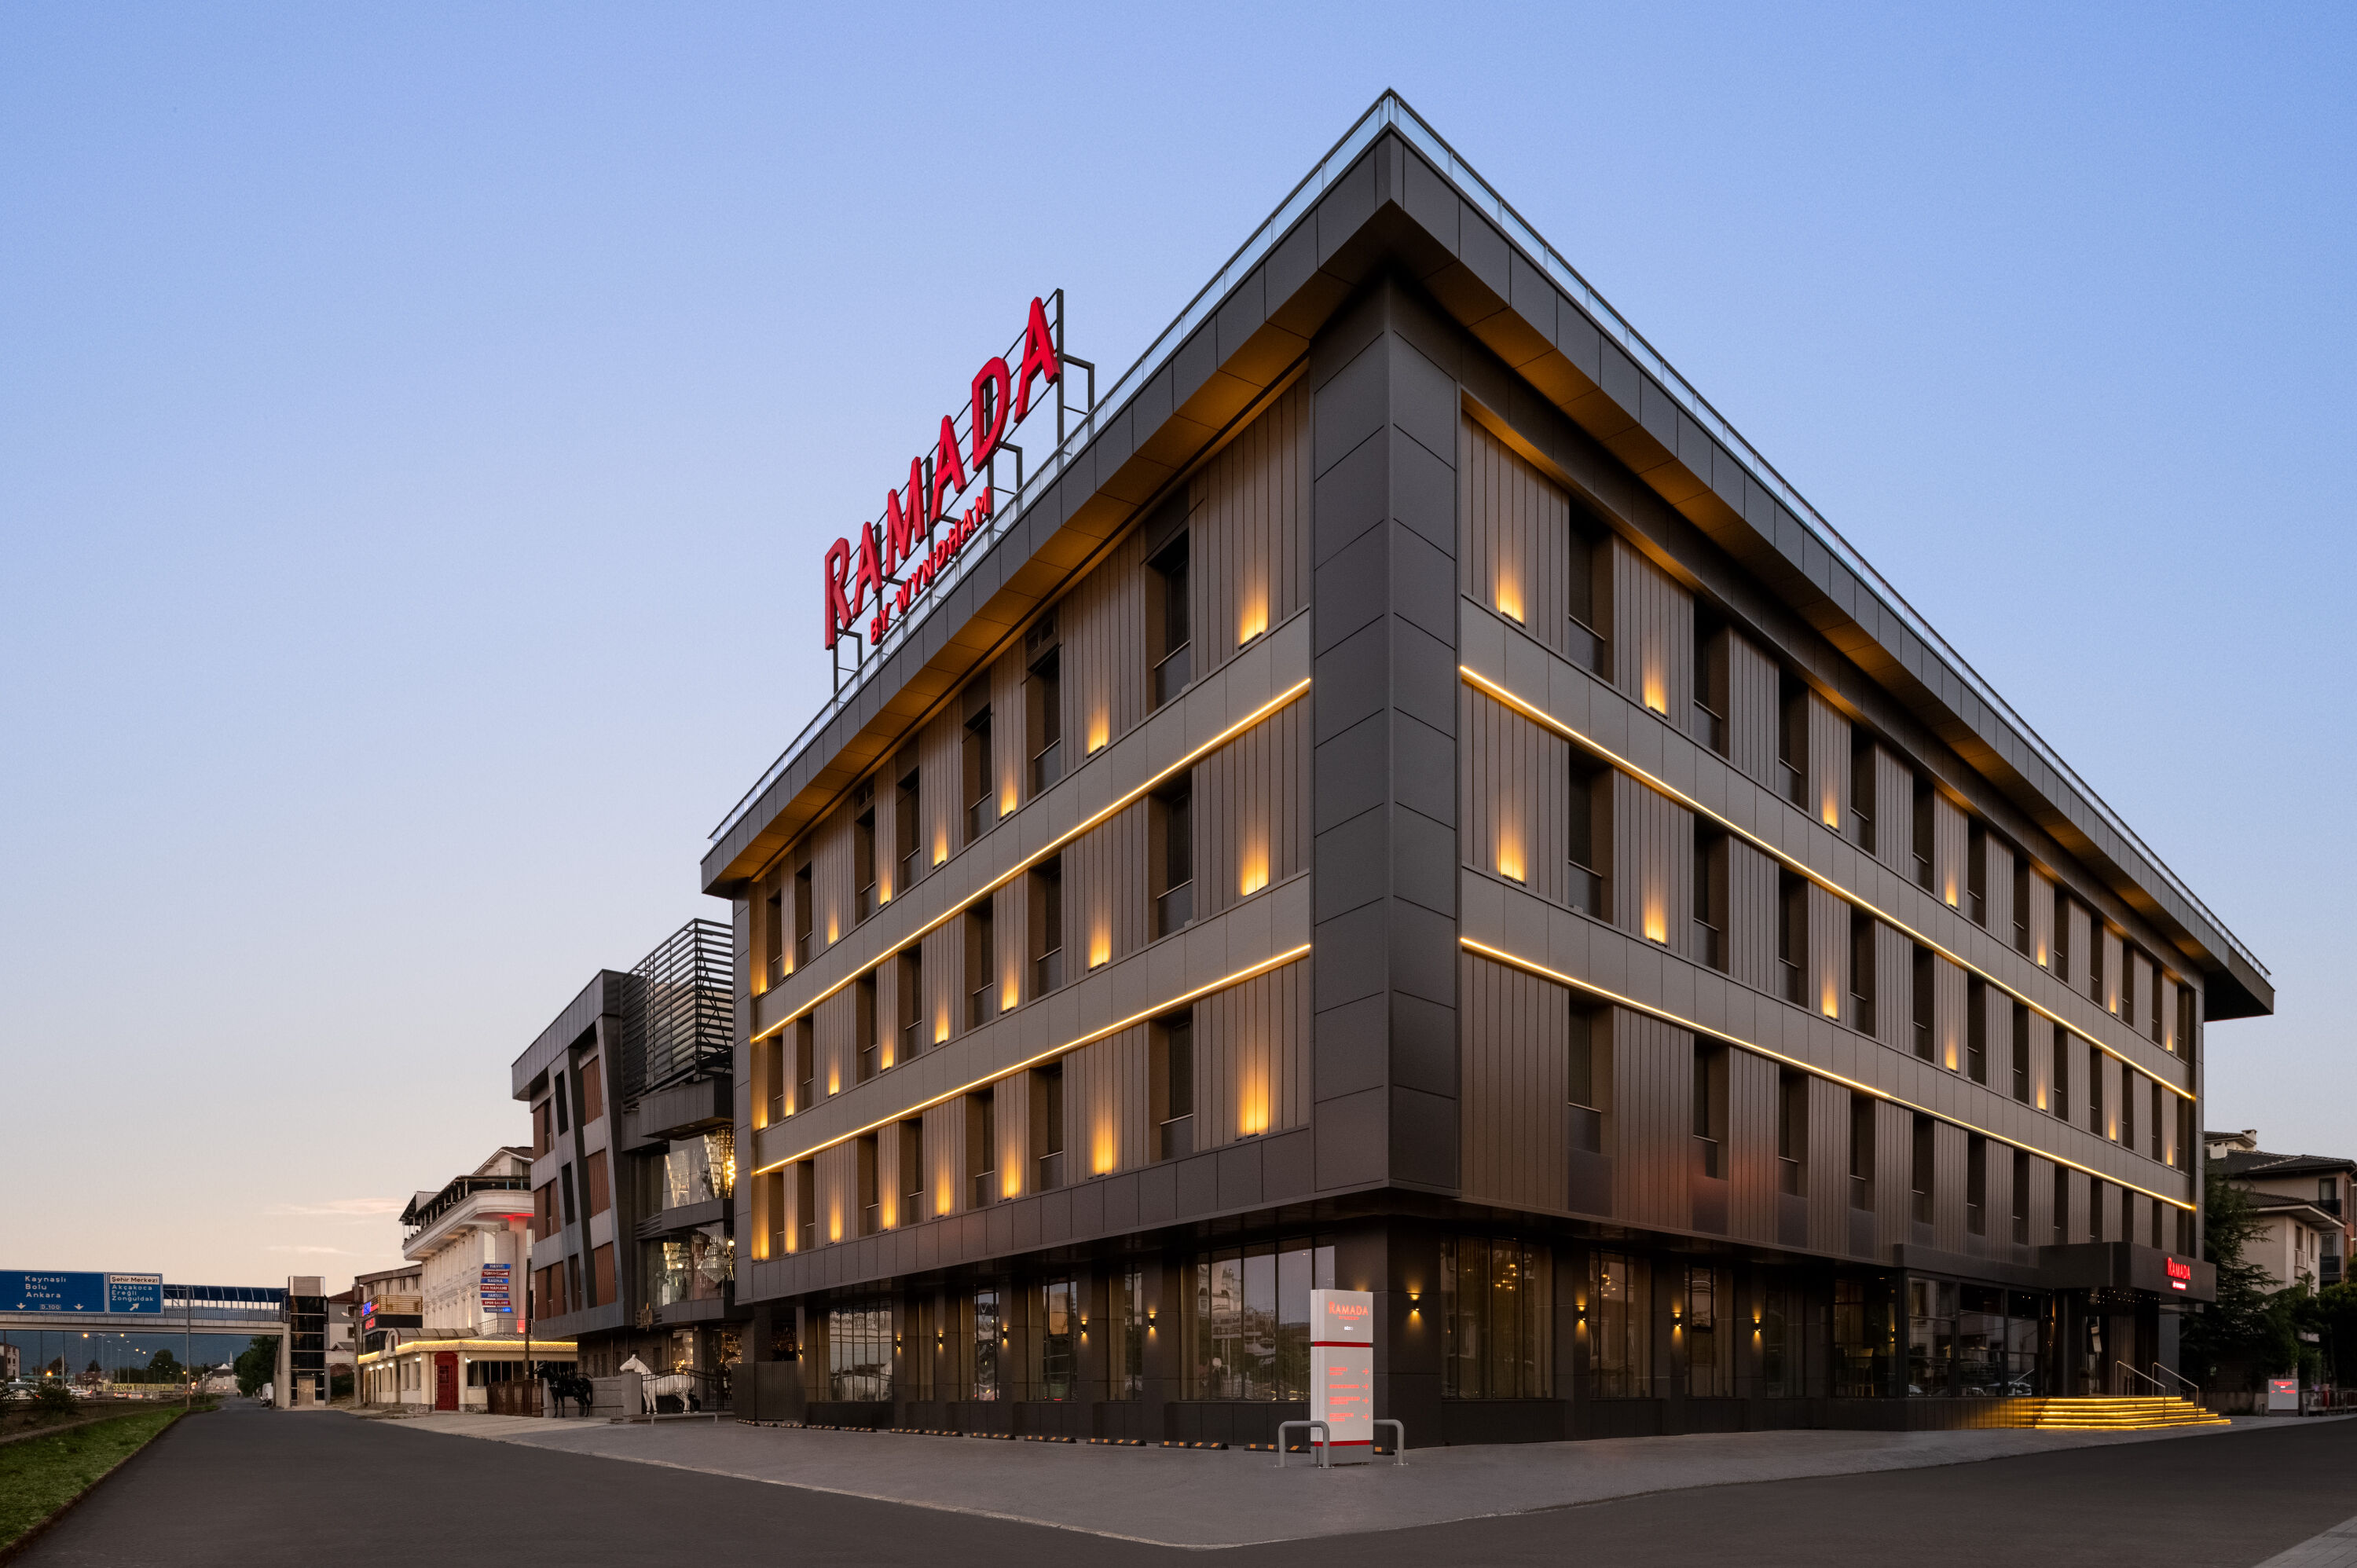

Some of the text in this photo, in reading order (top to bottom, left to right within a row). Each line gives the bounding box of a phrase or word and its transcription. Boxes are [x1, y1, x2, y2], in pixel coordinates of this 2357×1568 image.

[825, 296, 1061, 650] RAMADA
[870, 486, 992, 646] BY WYNDHAM
[24, 1275, 67, 1284] Kaynaşlı
[2167, 1257, 2191, 1280] RAMADA
[1329, 1301, 1369, 1316] RAMADA
